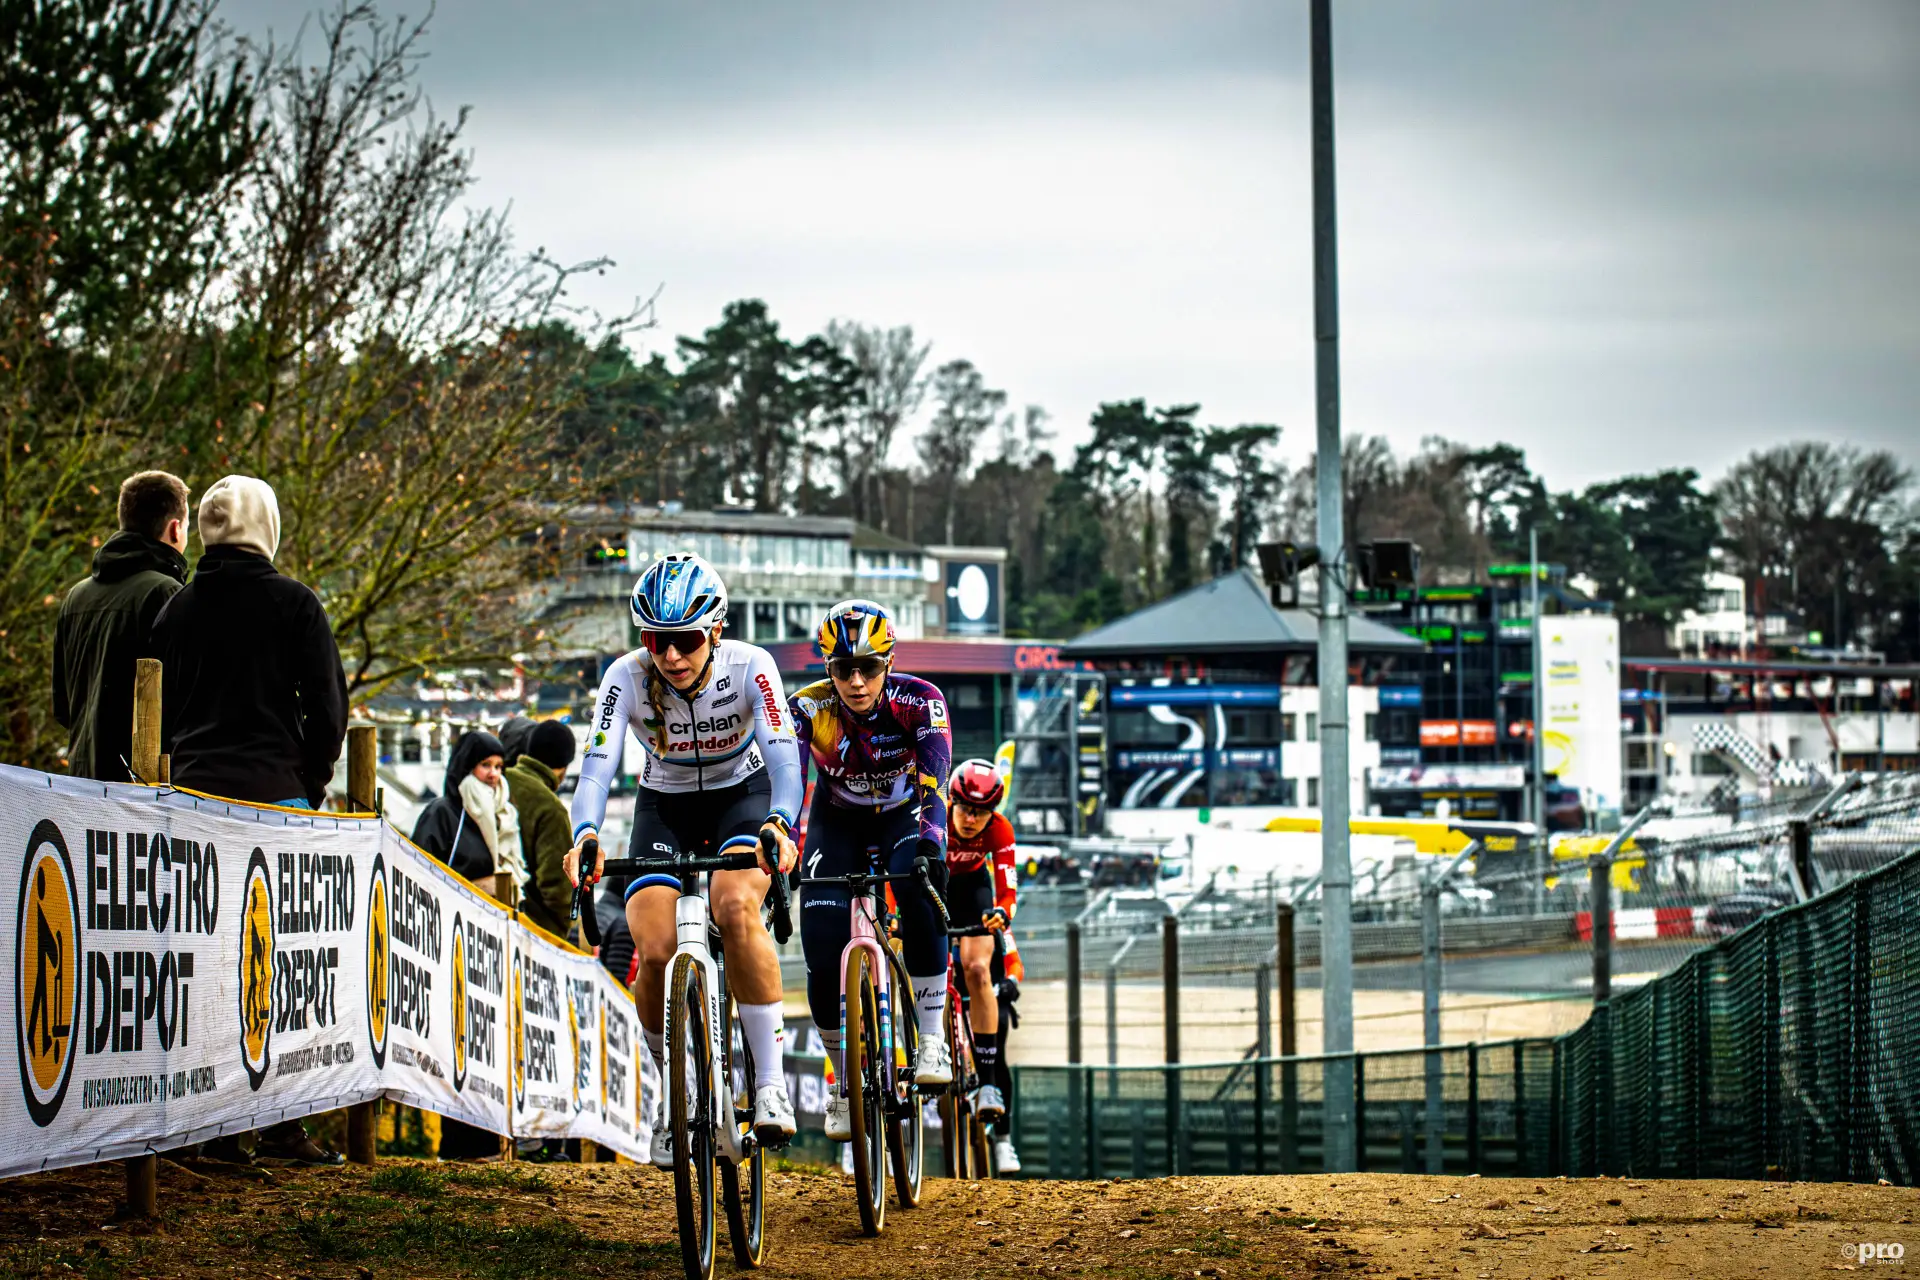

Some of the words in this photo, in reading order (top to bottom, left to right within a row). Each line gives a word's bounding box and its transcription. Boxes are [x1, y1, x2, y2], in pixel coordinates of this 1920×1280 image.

[600, 685, 622, 730] crelan
[669, 713, 741, 735] crelan
[755, 673, 782, 727] corendon
[933, 700, 943, 717] 5
[648, 732, 739, 752] crendon
[86, 829, 219, 936] ELECTRO
[277, 852, 355, 934] ELECTRO
[391, 866, 441, 964] ELECTRO
[804, 899, 836, 908] dolmans
[276, 946, 338, 1033] DEPOT
[391, 952, 431, 1039] DEPOT
[467, 920, 503, 998] ELECTRO
[85, 951, 194, 1055] DEPOT
[467, 995, 496, 1069] DEPOT
[710, 994, 720, 1047] STEVENS
